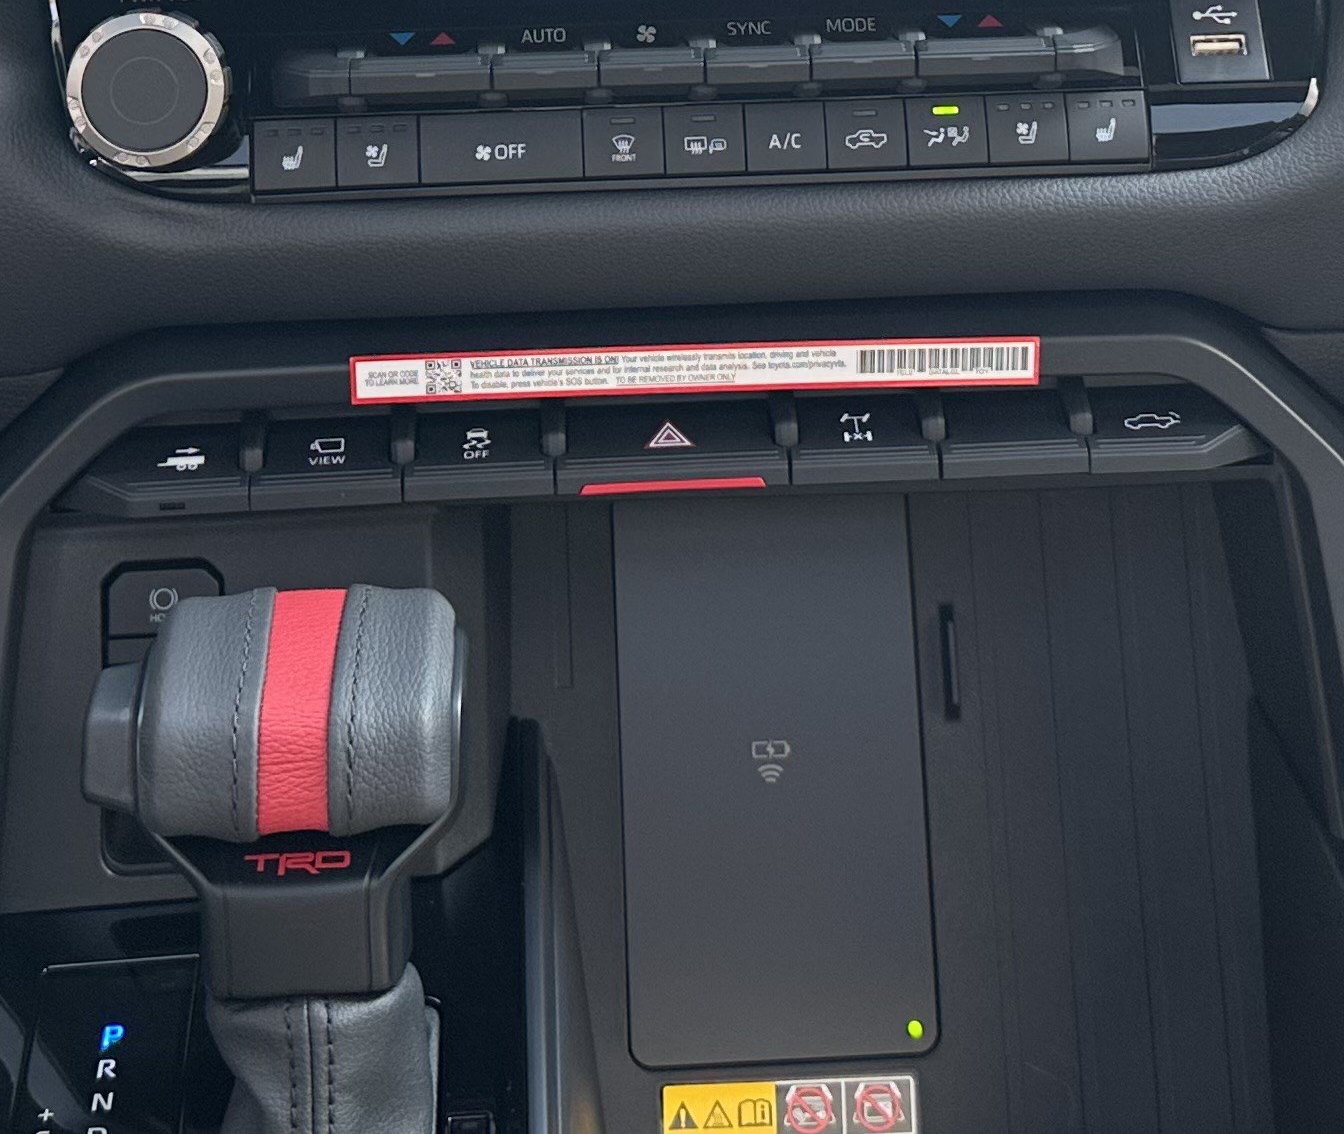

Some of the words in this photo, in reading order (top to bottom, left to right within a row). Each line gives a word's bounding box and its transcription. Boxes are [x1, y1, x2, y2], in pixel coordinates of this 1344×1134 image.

[726, 20, 772, 37] SYNC
[826, 16, 877, 33] MODE
[521, 27, 567, 45] AUTO
[768, 130, 802, 151] A/C
[494, 142, 527, 161] OFF
[611, 153, 637, 162] FRONT
[470, 358, 504, 368] VEHICLE
[507, 357, 529, 367] DATA
[531, 355, 593, 366] TRANSMISSION
[308, 455, 346, 466] VIEW
[463, 449, 490, 460] OFF
[149, 612, 166, 623] HO
[244, 850, 351, 876] TRD
[100, 1024, 125, 1052] P
[96, 1058, 117, 1079] R
[91, 1091, 114, 1112] N
